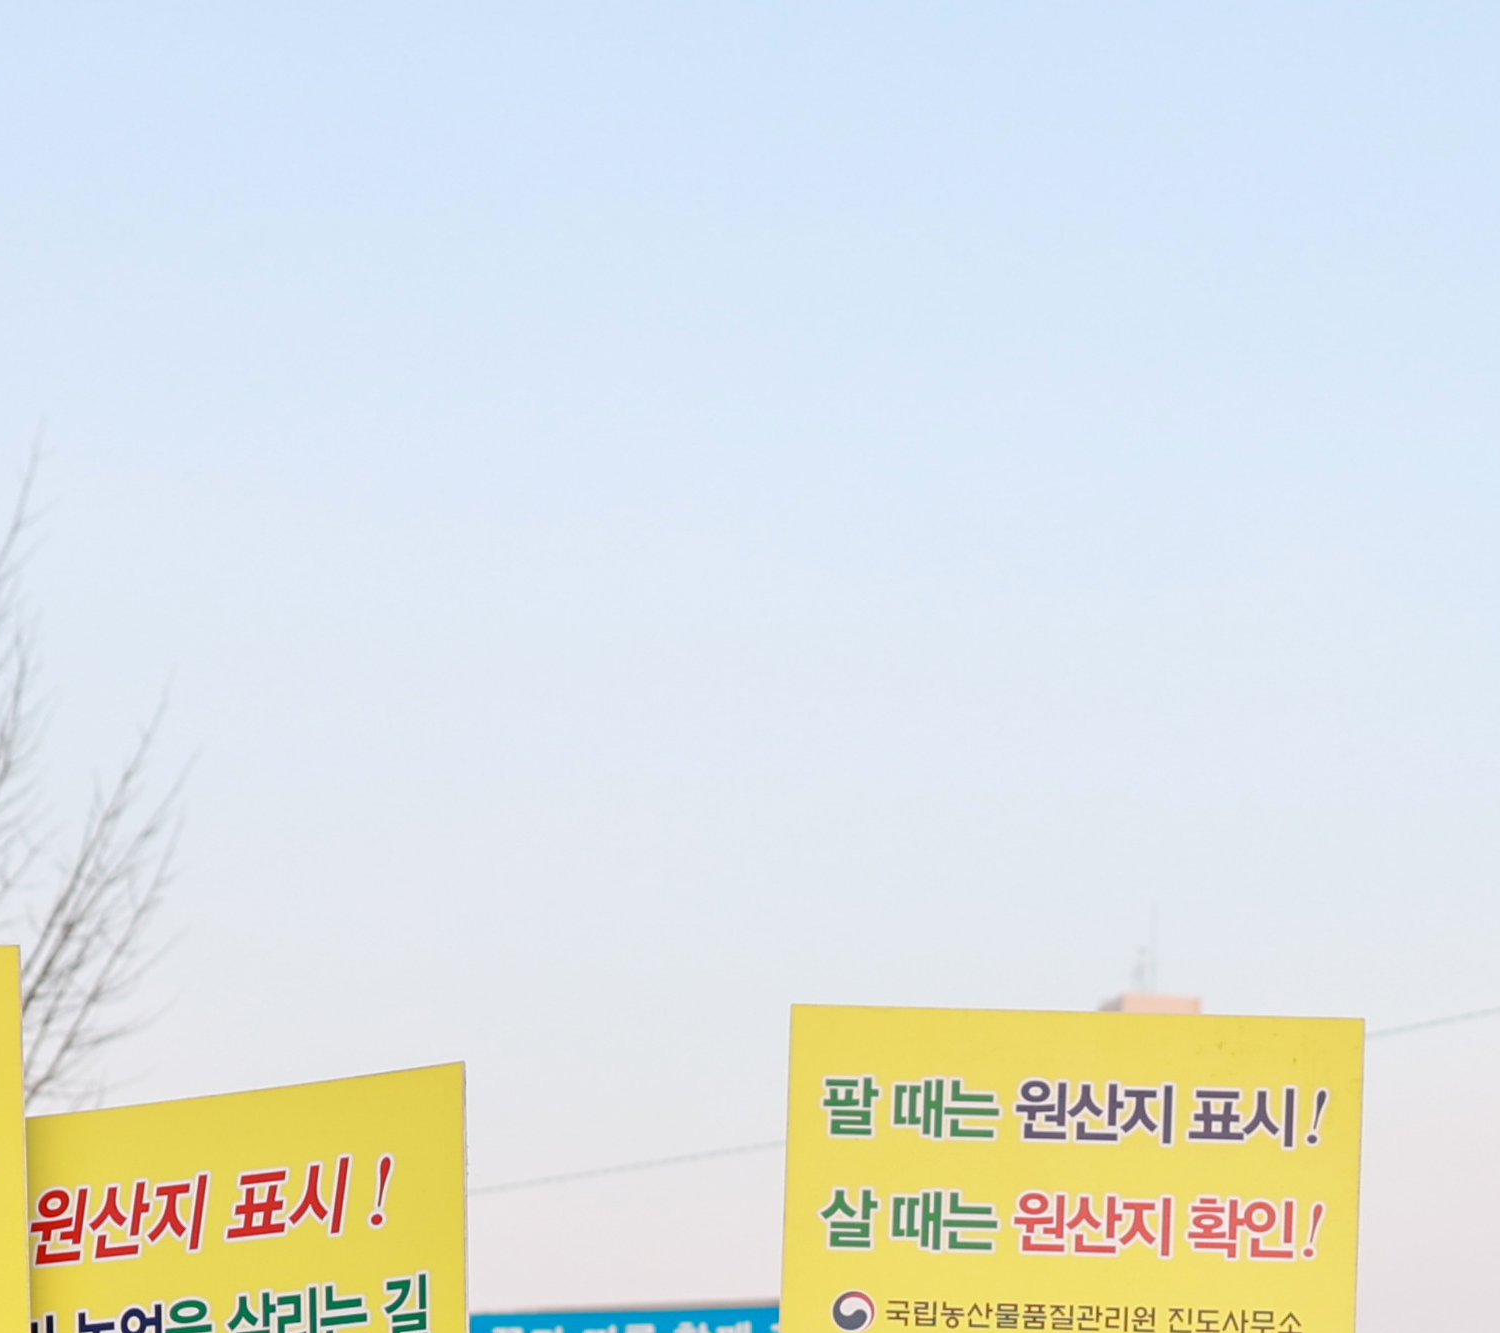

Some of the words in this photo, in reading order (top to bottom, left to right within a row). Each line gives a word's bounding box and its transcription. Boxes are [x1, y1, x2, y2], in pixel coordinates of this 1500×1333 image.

[823, 1075, 878, 1136] 팔
[893, 1080, 999, 1141] 때는
[1016, 1078, 1174, 1146] 원산지
[1187, 1086, 1328, 1148] 표시!
[31, 1172, 209, 1267] 원산지
[820, 1188, 877, 1251] 살
[892, 1191, 998, 1253] 때는
[1014, 1191, 1172, 1258] 원산지
[1187, 1196, 1326, 1260] 확인!
